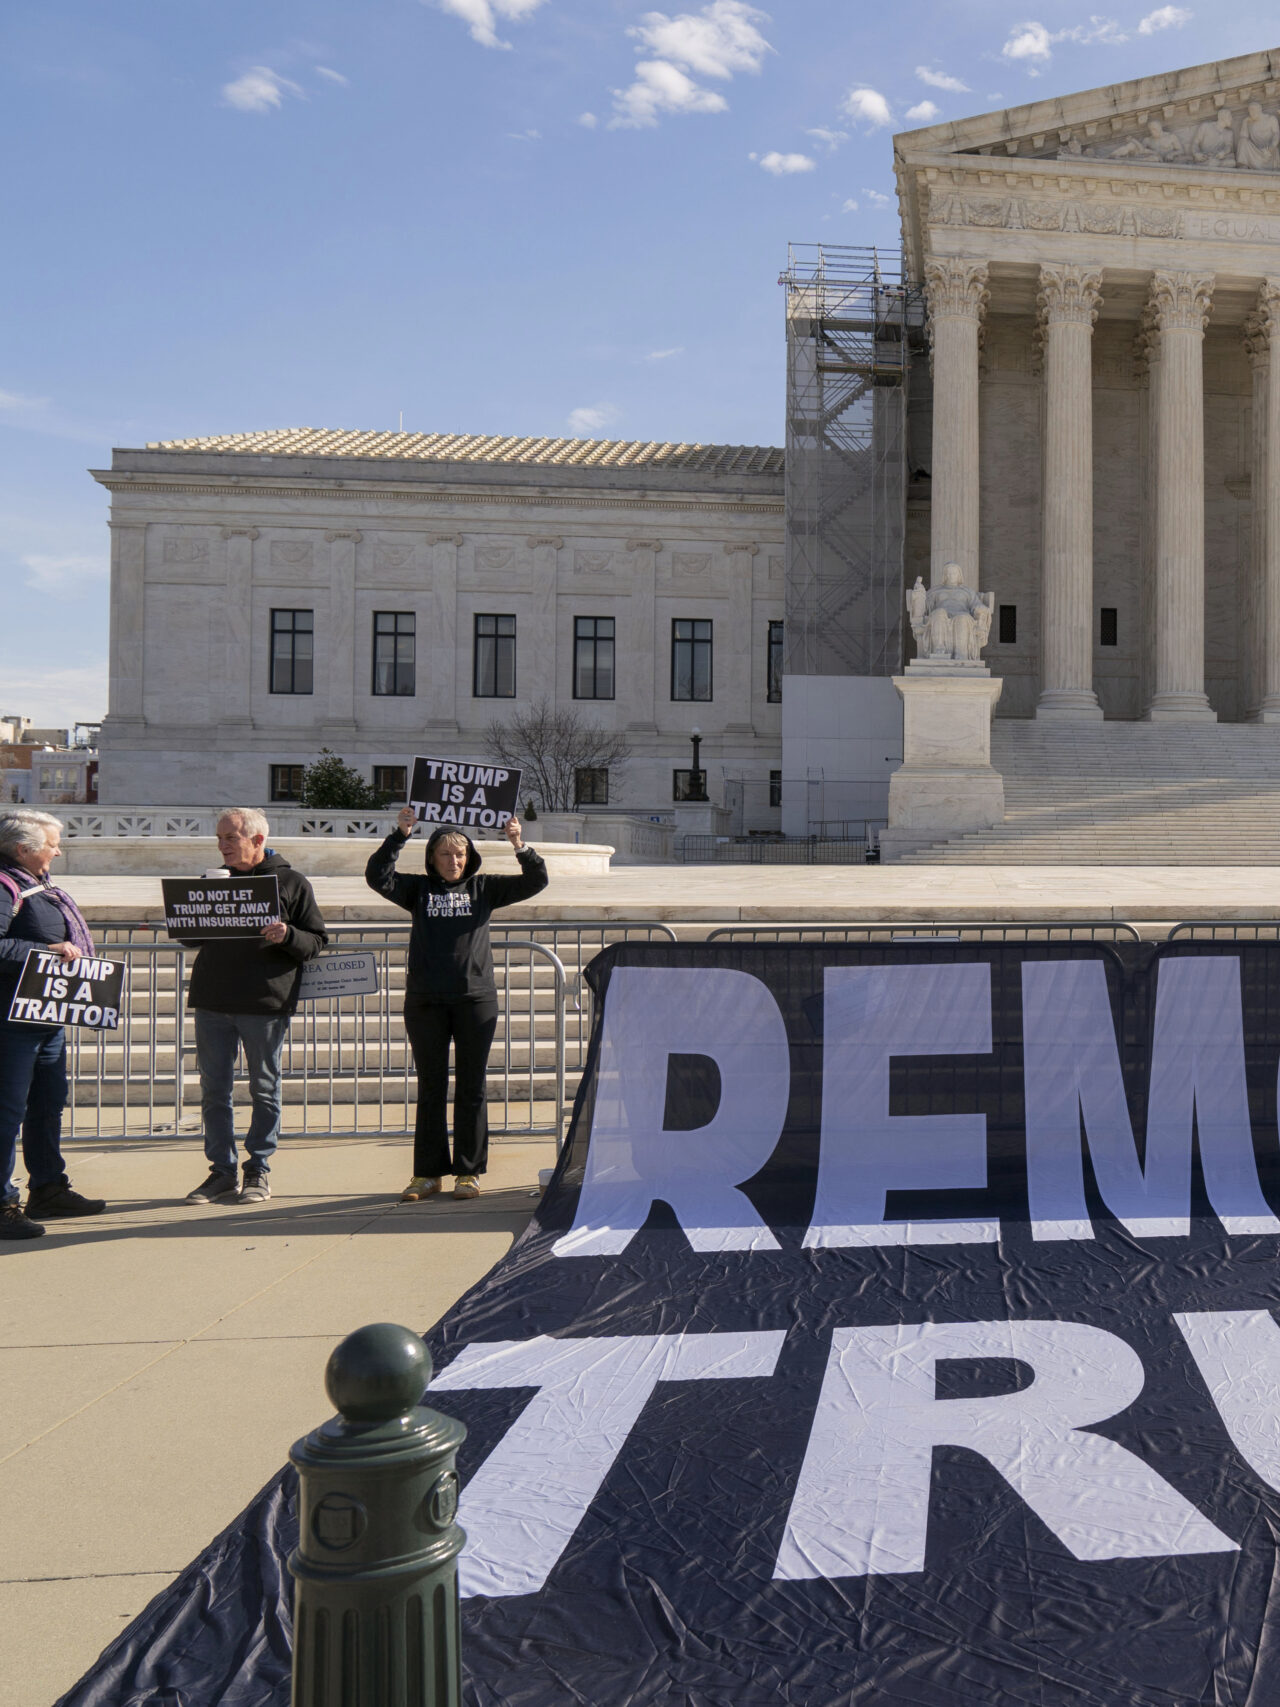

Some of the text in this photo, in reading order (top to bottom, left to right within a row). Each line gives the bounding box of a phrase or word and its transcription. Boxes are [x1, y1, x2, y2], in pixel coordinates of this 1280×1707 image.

[1200, 219, 1278, 240] EQUAL
[426, 760, 509, 788] TRUMP
[441, 783, 487, 806] IS A
[410, 800, 513, 828] TRAITOR
[188, 889, 253, 902] DO NOT LET
[428, 892, 470, 902] TRUMP IS
[173, 902, 271, 915] TRUMP GET AWAY
[427, 900, 471, 909] A DANGER
[427, 906, 473, 917] TO US ALL
[167, 915, 280, 928] WITH INSURRECTION
[37, 953, 115, 981] TRUMP
[302, 960, 366, 974] REA CLOSED
[43, 977, 93, 1002] IS A
[15, 998, 118, 1028] TRAITOR
